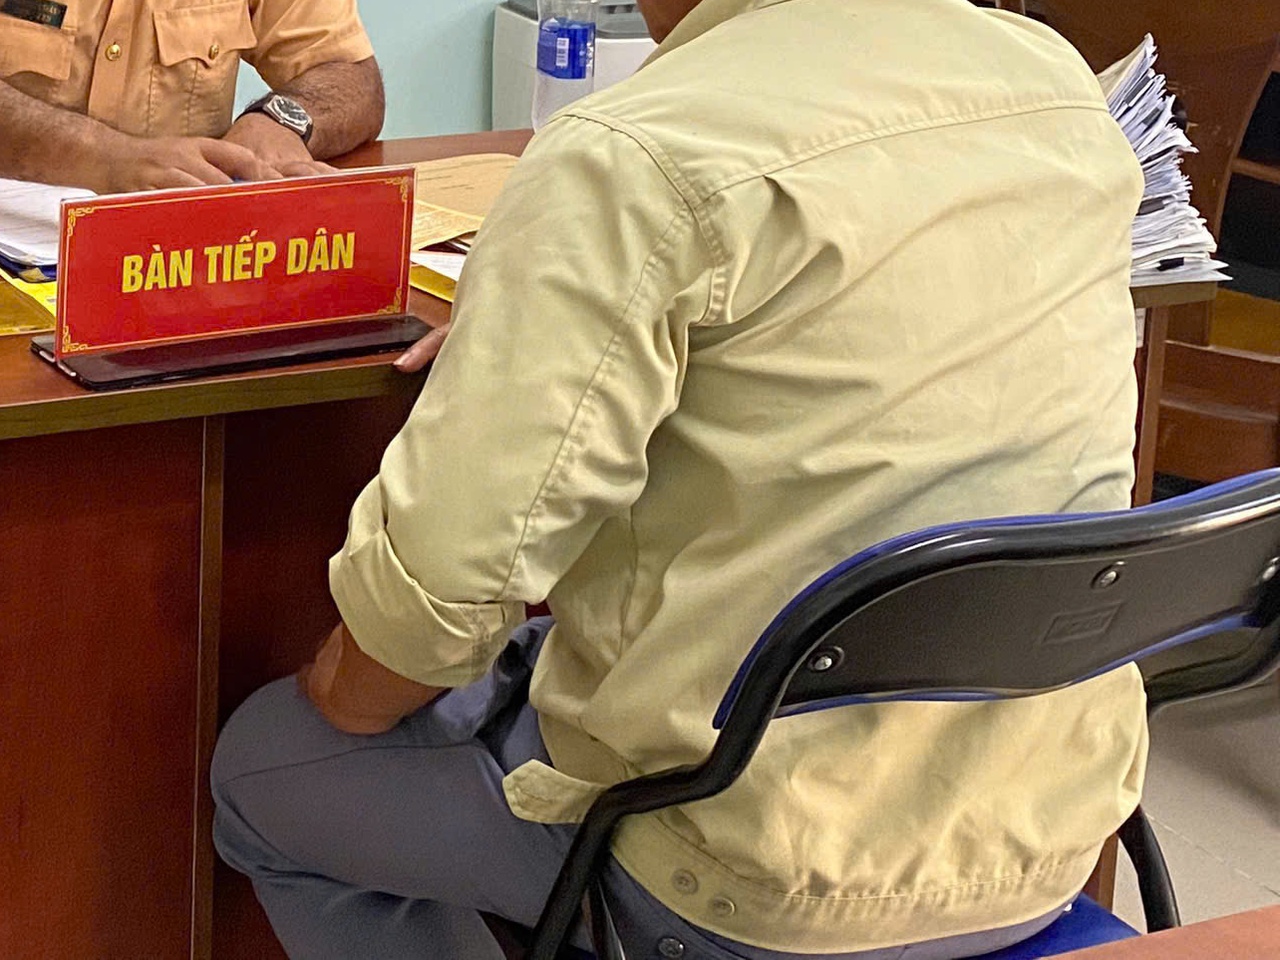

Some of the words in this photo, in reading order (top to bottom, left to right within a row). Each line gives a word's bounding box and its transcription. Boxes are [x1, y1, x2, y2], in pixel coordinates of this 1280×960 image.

[122, 243, 193, 293] BÀN
[203, 229, 277, 284] TIẾP
[287, 227, 356, 276] DÂN
